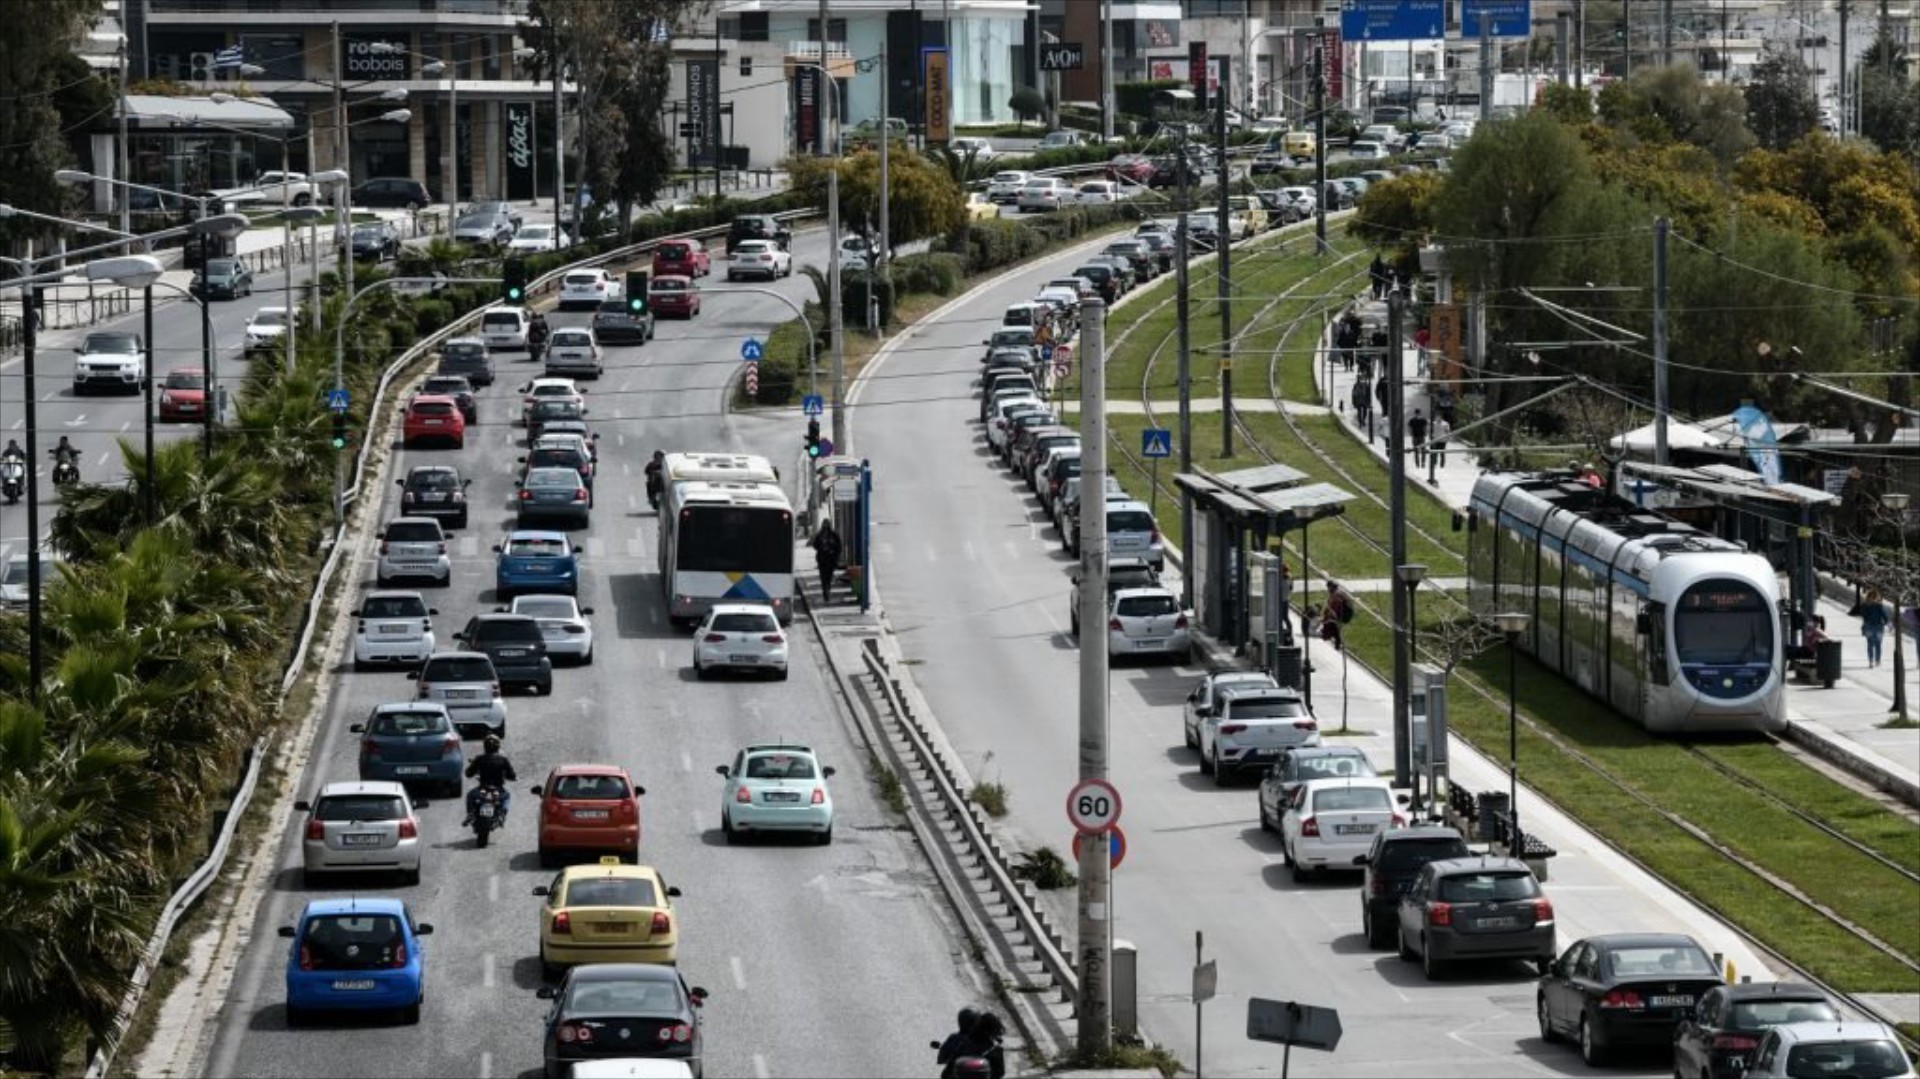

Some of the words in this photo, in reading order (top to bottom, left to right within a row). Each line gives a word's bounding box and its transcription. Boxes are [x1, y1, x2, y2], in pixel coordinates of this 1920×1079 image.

[348, 56, 404, 71] bobois
[931, 66, 942, 128] COCO-MAT
[1079, 796, 1109, 817] 60
